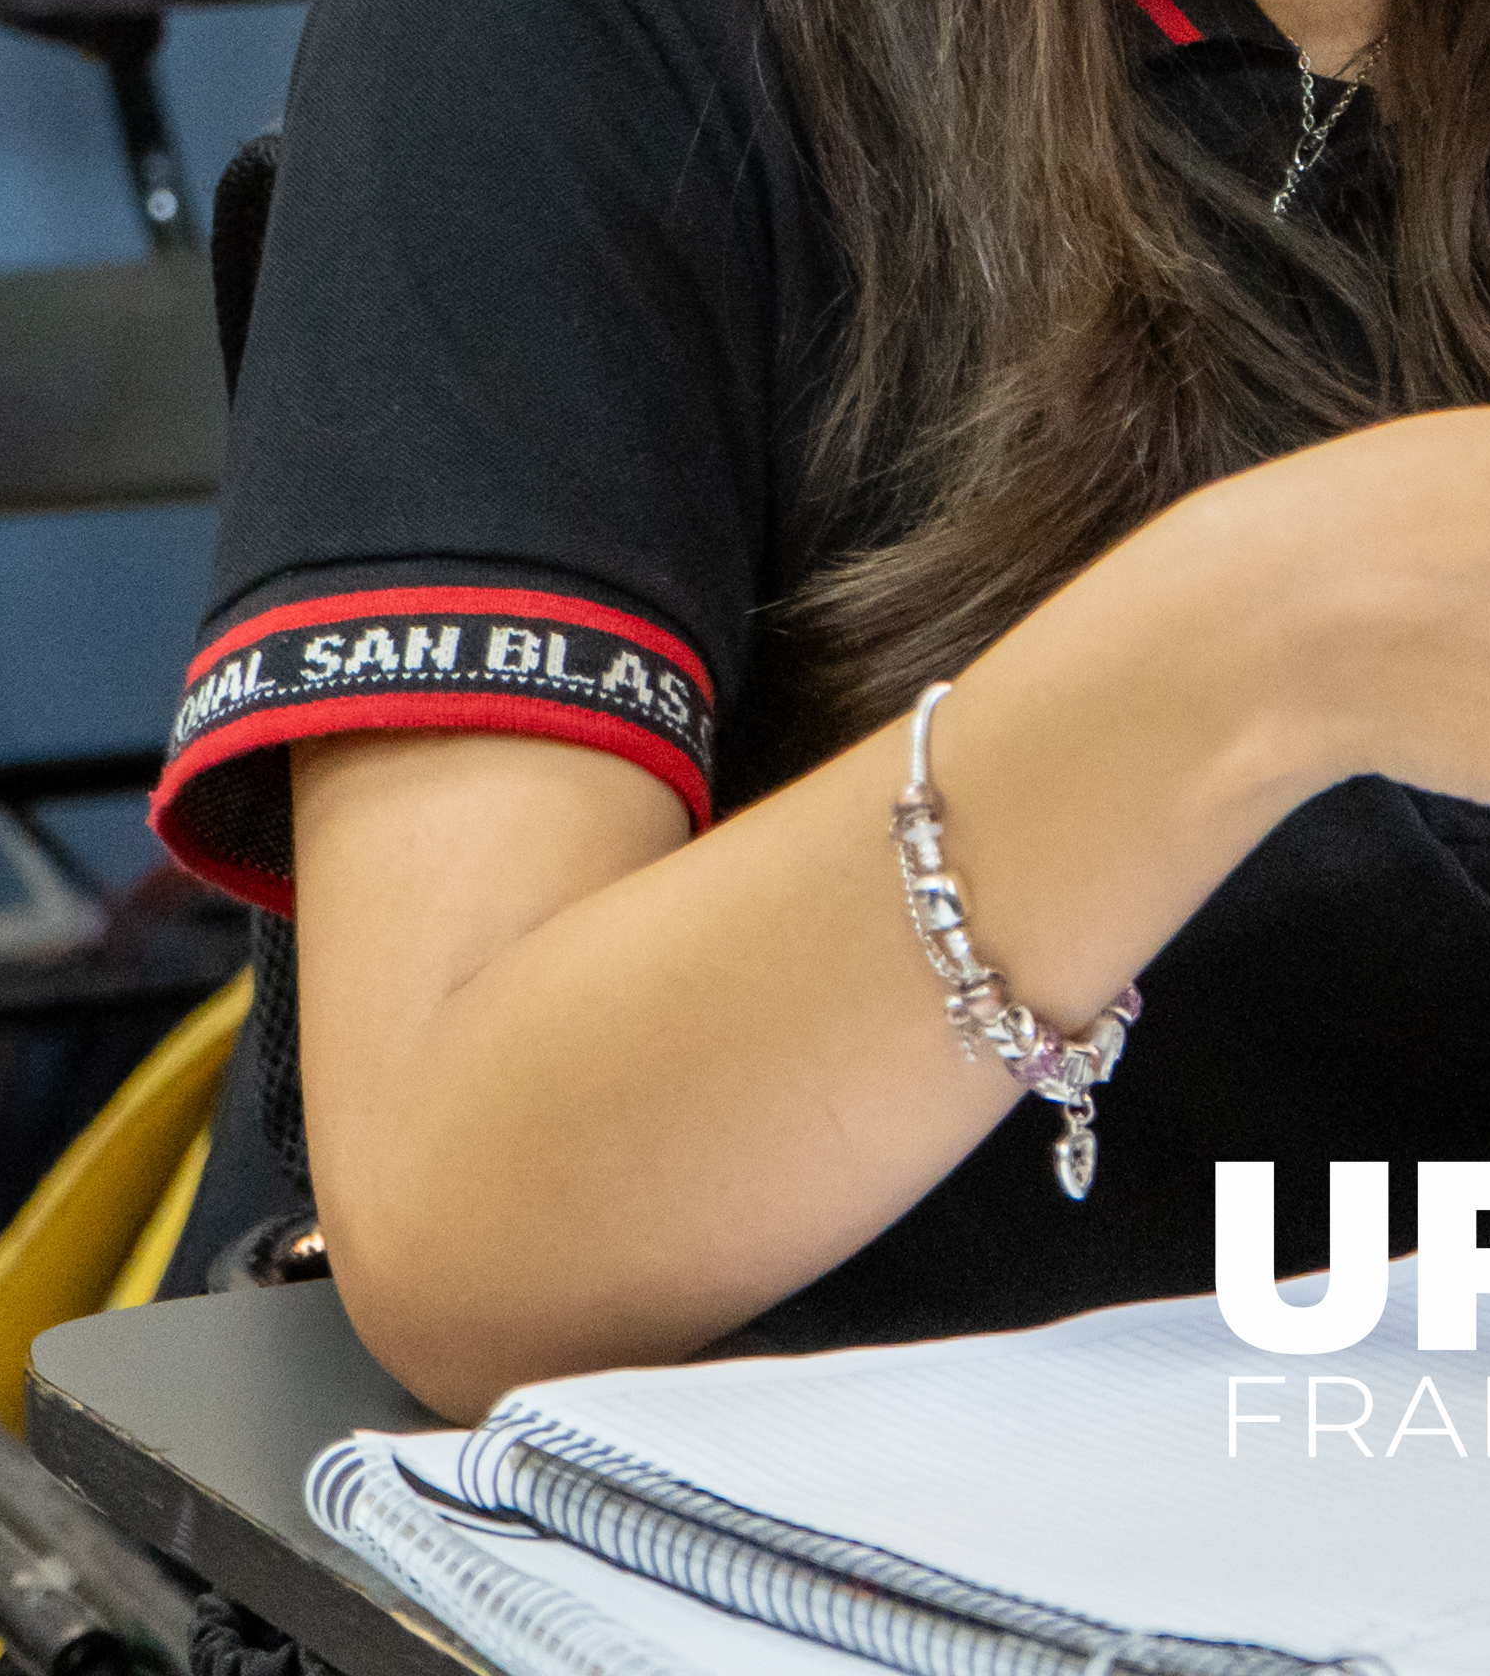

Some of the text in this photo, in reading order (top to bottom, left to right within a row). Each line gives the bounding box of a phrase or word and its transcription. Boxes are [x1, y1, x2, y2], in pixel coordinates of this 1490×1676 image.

[174, 625, 691, 744] ONAL SAN BLAS
